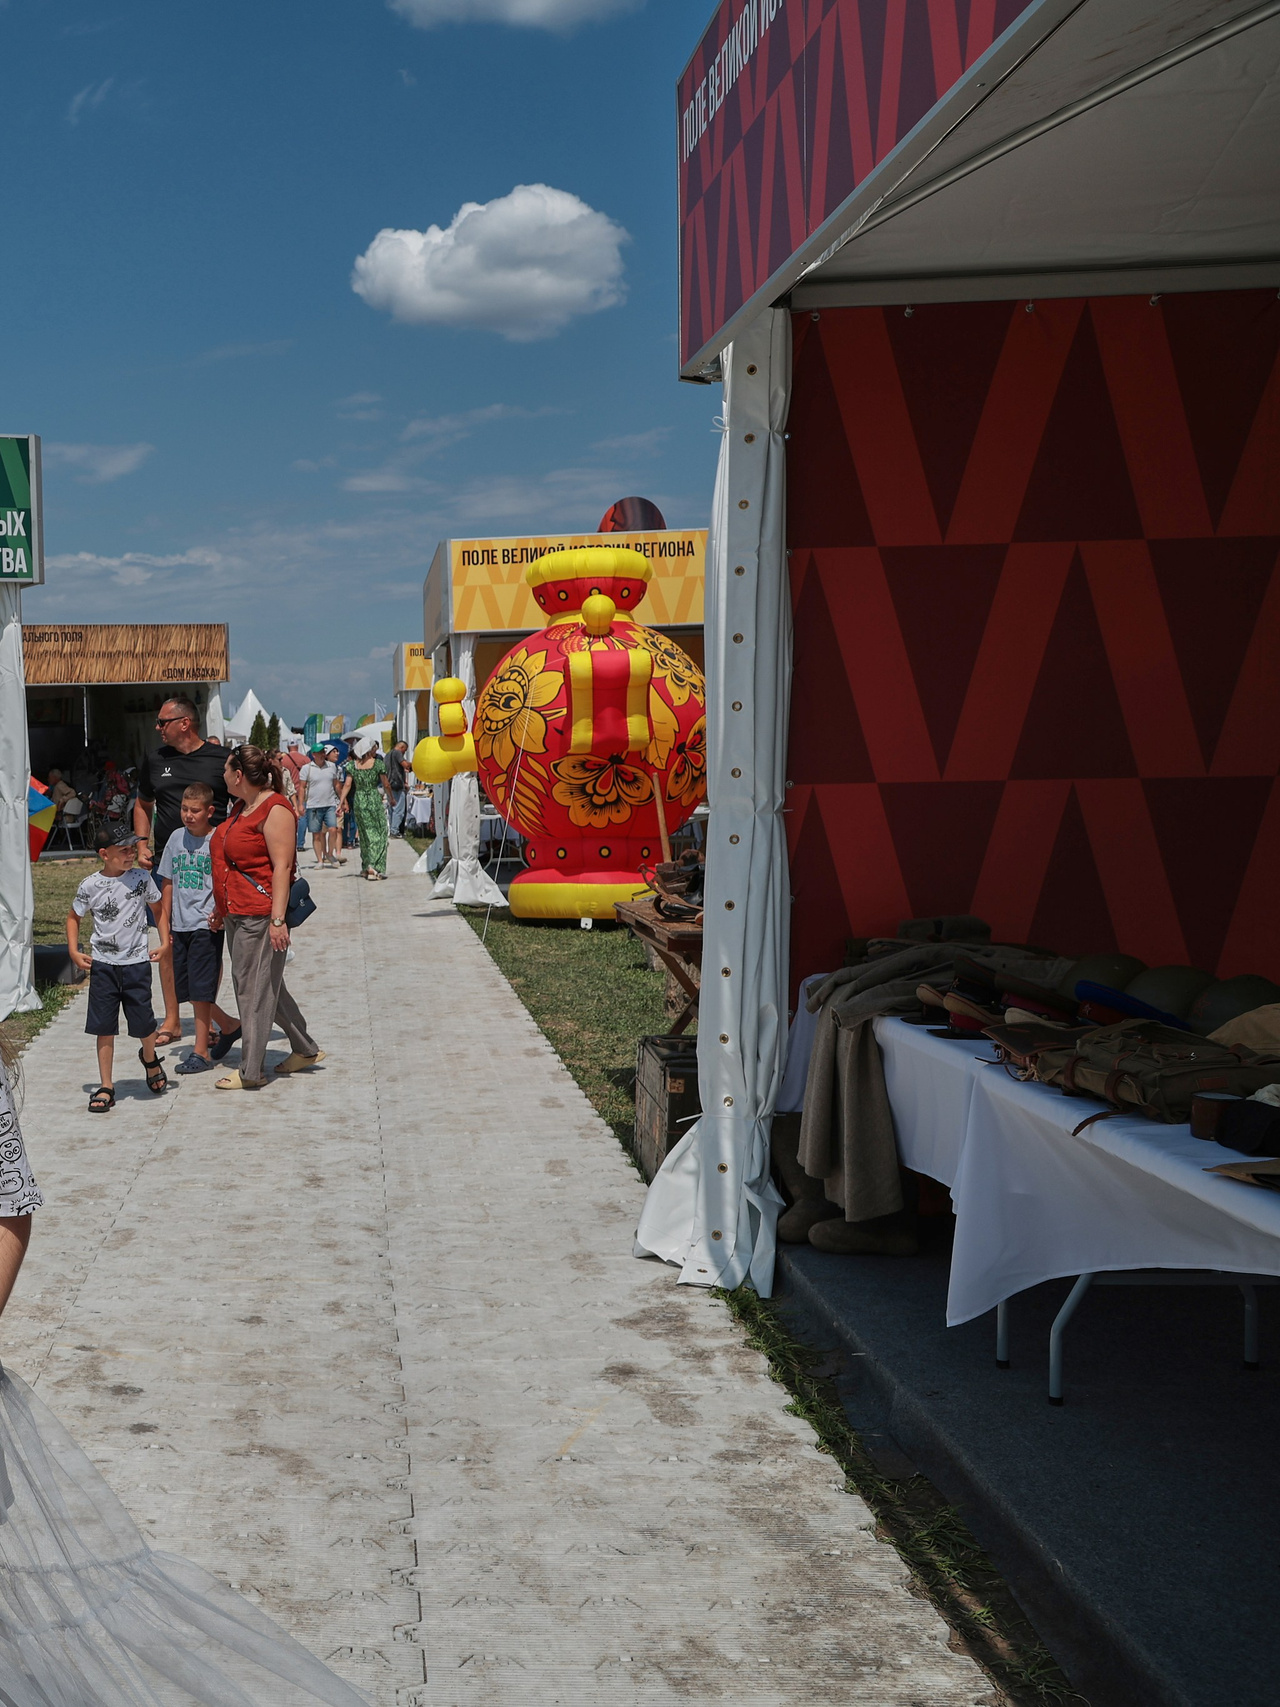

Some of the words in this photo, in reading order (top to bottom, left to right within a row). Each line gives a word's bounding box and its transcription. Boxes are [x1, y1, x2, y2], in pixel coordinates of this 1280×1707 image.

[683, 77, 707, 163] ПОЛЕ
[462, 548, 498, 567] ПОЛЕ
[634, 541, 695, 558] РЕГИОНА
